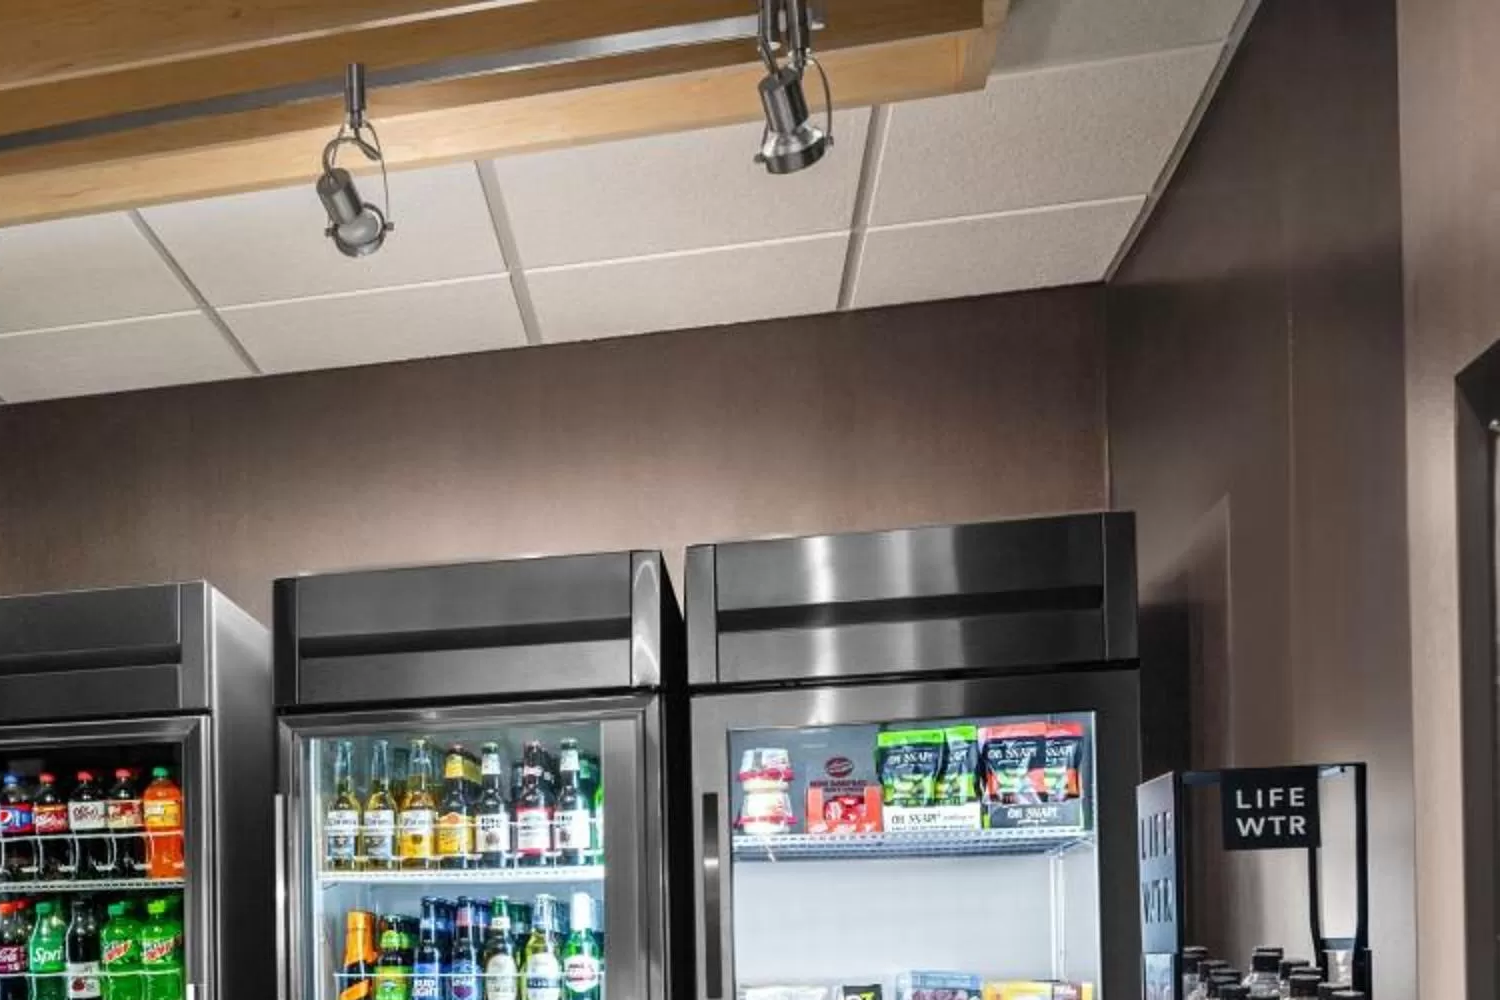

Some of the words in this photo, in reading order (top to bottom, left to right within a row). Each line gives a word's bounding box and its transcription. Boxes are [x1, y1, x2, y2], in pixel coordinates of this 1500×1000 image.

[1236, 787, 1305, 809] LIFE
[1142, 811, 1172, 861] LIFE
[1236, 815, 1306, 837] WTR
[1143, 877, 1173, 924] WTR
